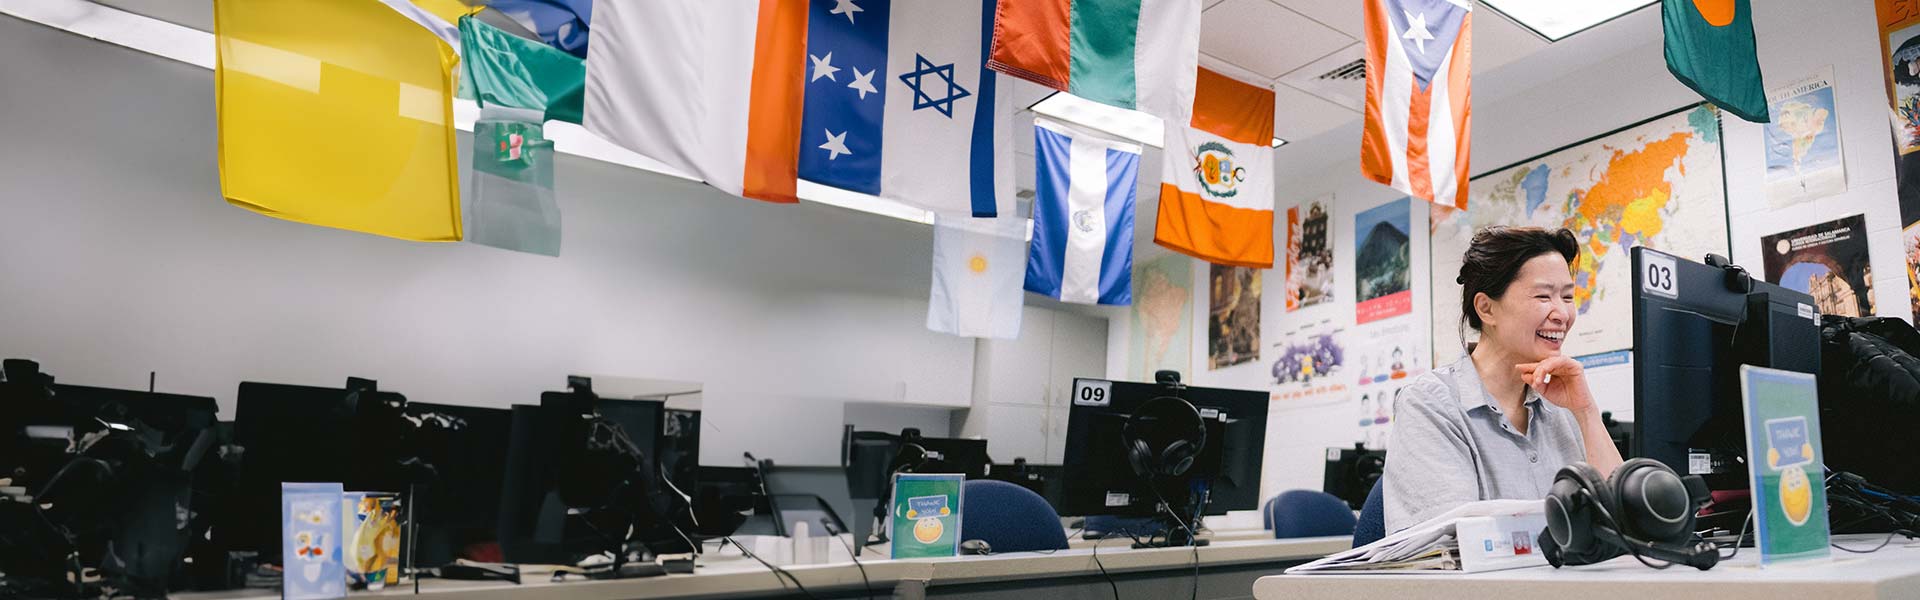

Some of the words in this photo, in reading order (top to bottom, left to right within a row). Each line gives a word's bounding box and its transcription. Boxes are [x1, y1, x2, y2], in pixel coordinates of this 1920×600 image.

[1792, 80, 1828, 96] AMERICA
[1649, 263, 1671, 290] 03
[1081, 386, 1105, 402] 09
